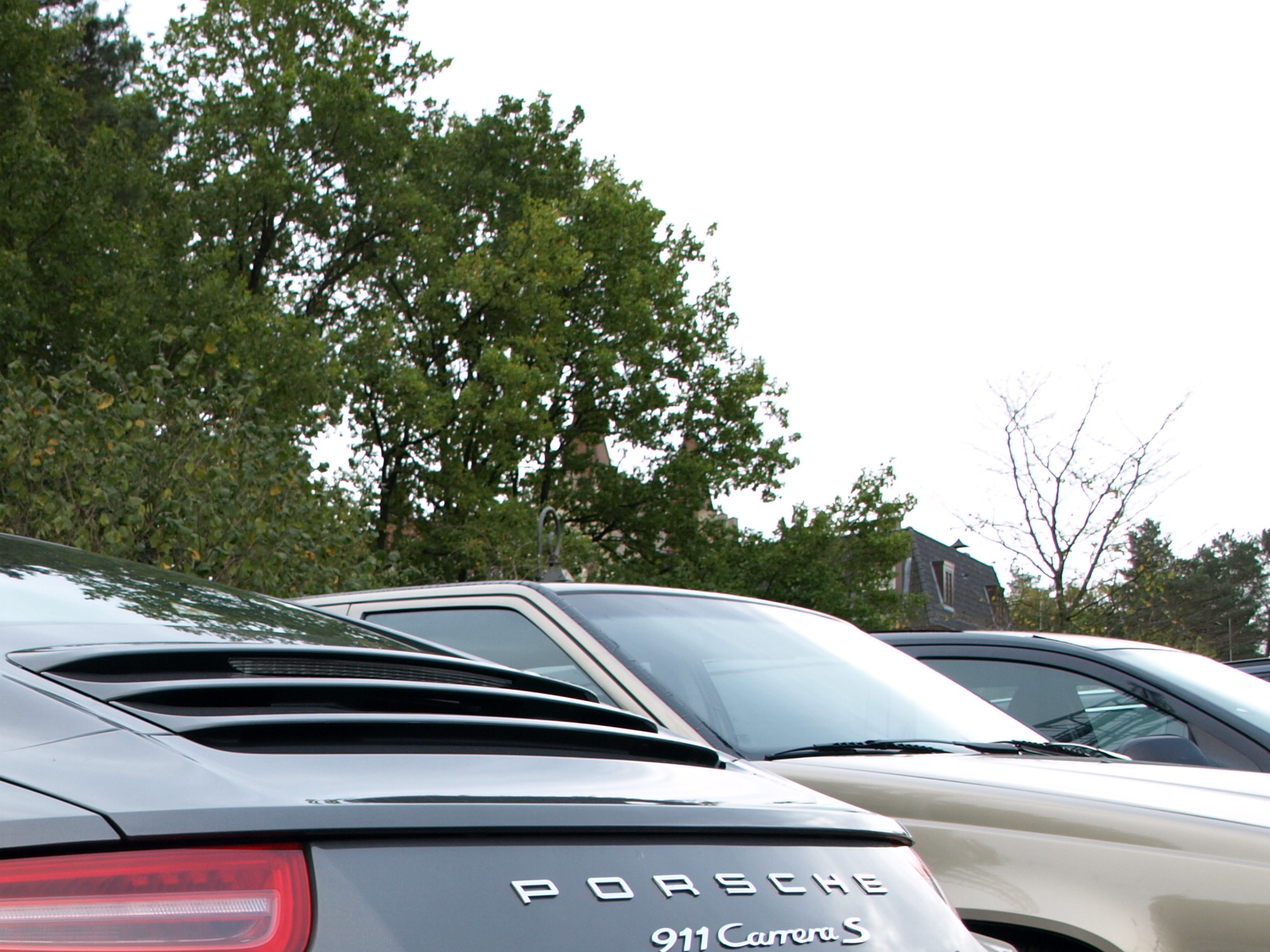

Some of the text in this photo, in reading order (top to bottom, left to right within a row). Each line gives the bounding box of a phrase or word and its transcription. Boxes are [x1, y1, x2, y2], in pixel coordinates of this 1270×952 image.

[510, 872, 889, 905] PORSCHE
[716, 921, 840, 949] Carrera
[840, 916, 871, 946] S
